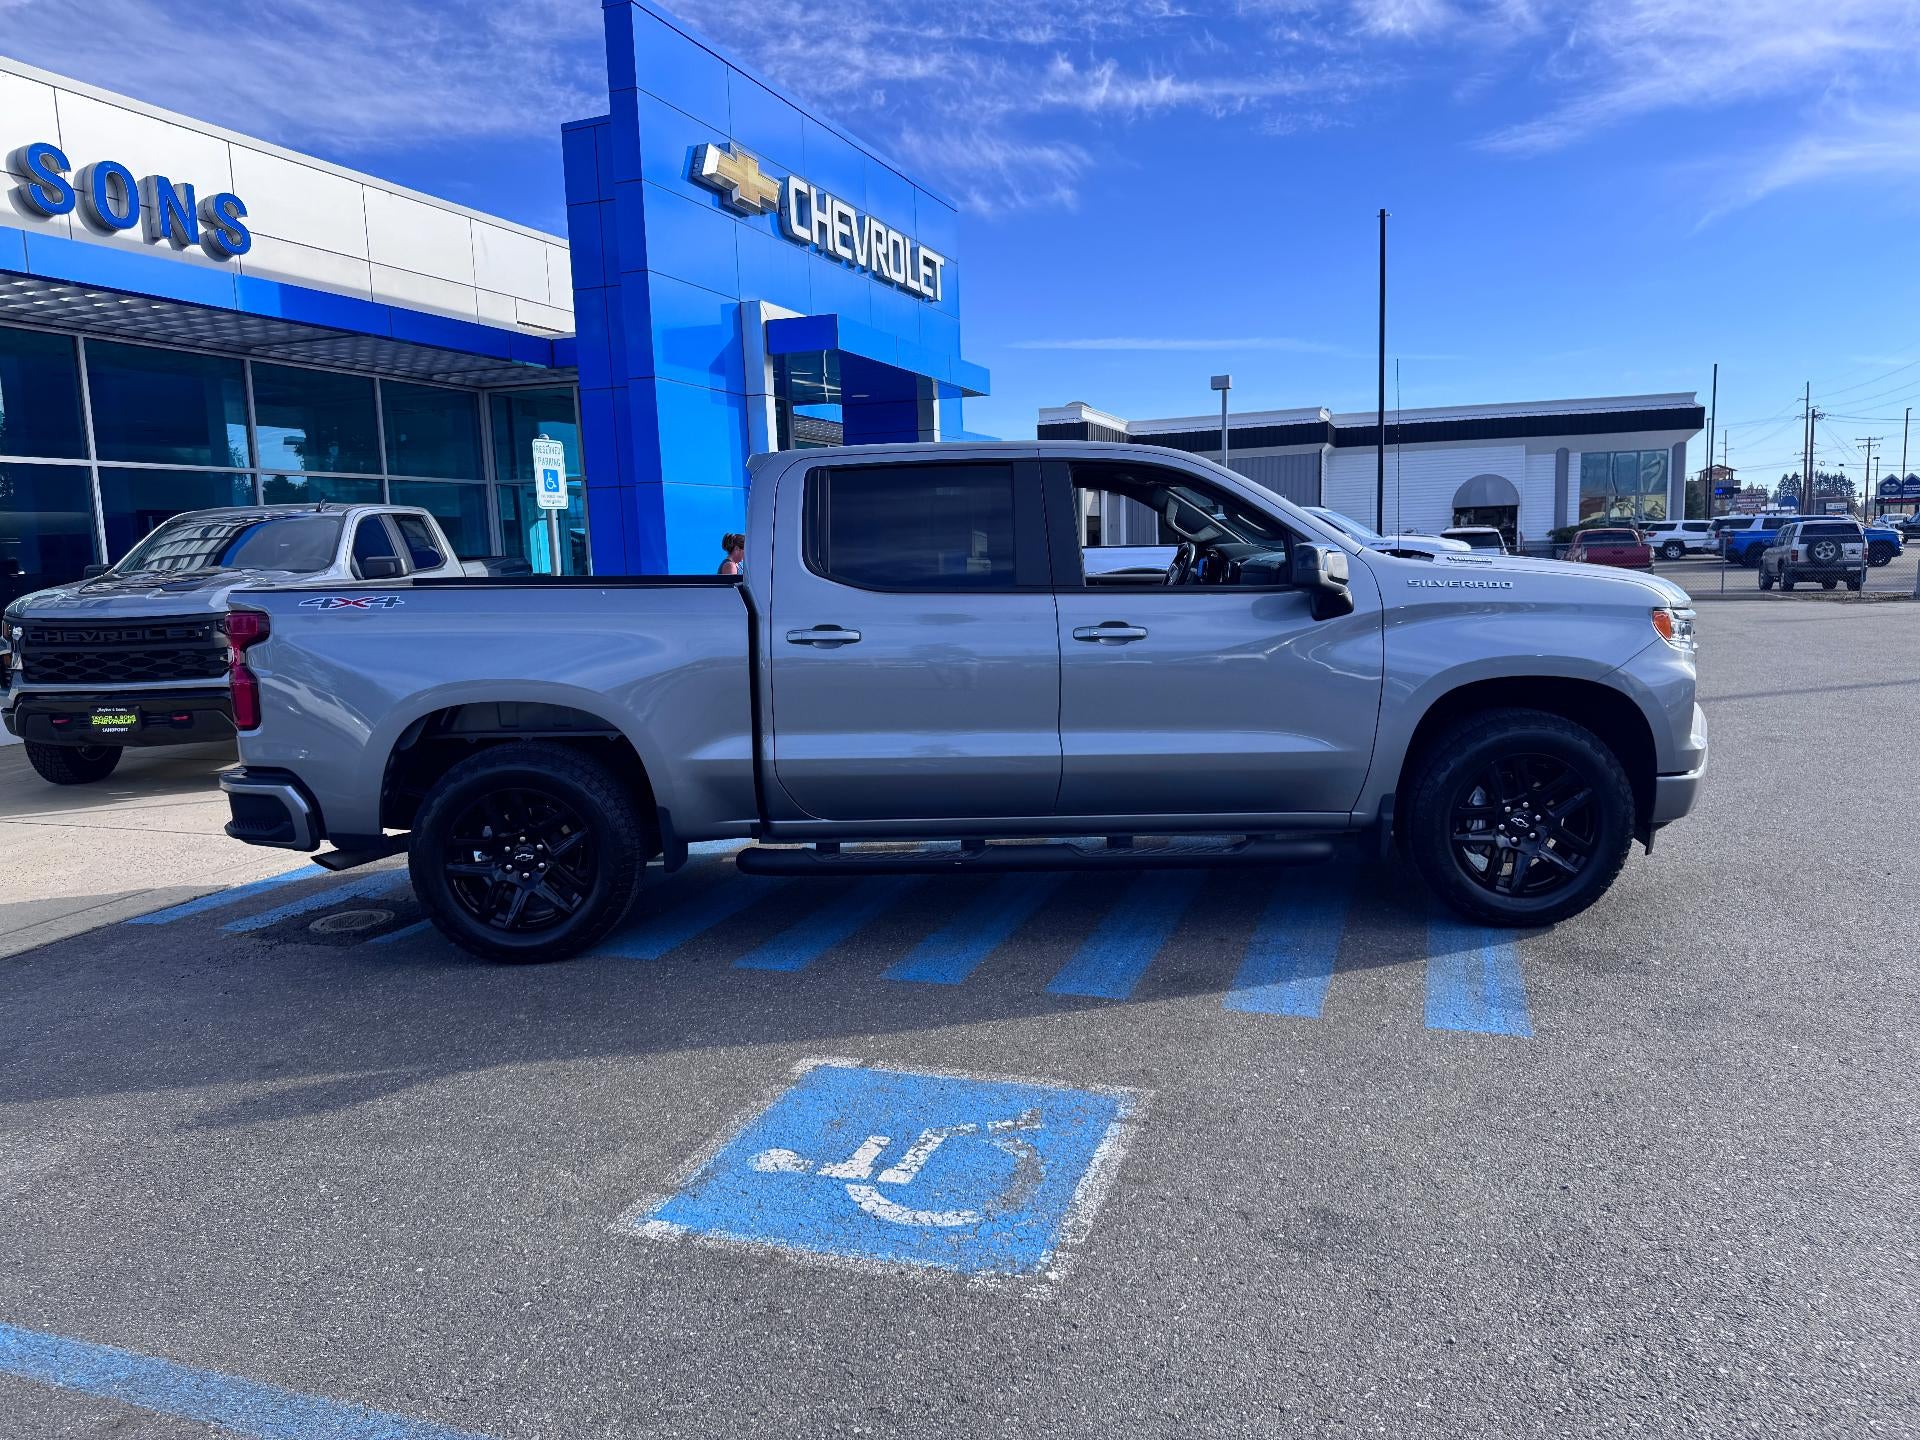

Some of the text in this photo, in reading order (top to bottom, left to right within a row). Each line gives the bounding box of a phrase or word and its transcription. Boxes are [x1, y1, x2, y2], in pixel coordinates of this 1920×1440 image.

[18, 142, 251, 256] SONS
[787, 175, 945, 301] CHEVROLET
[538, 456, 560, 467] PARKING
[1407, 579, 1513, 589] SILVERADO
